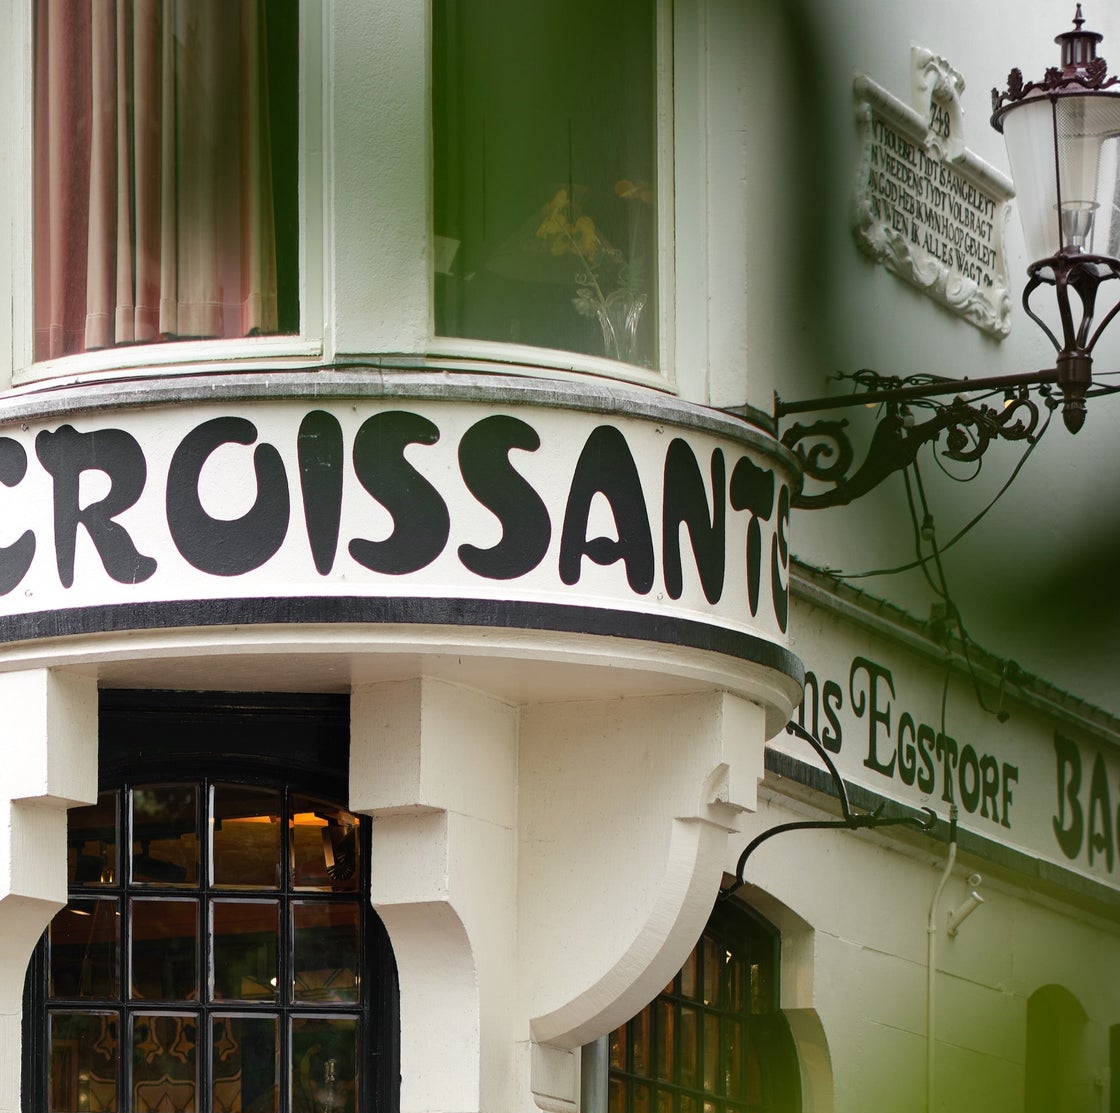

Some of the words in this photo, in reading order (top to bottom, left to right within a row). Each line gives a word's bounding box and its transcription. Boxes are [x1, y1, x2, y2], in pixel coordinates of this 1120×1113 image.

[879, 172, 897, 202] GOD
[898, 185, 915, 215] HEB
[941, 215, 964, 249] HOOP
[924, 176, 947, 211] TYDT
[948, 193, 993, 242] VOLBRAGT
[946, 169, 996, 220] AANGELEYT
[922, 231, 954, 267] ALLES
[955, 248, 983, 287] WAGT
[1052, 729, 1120, 875] BA
